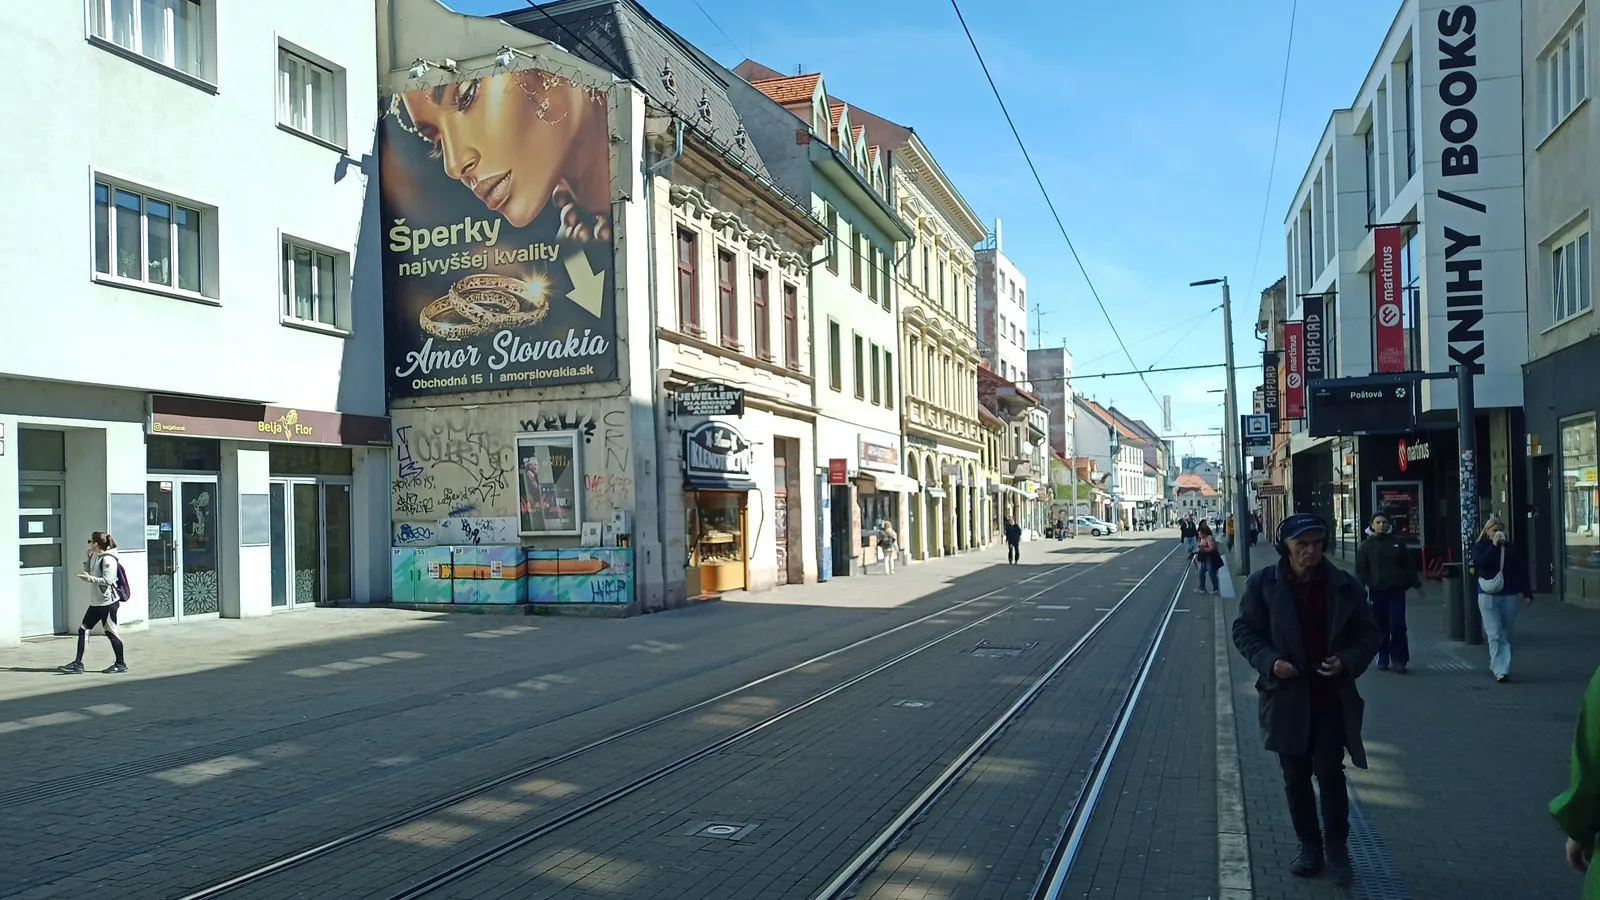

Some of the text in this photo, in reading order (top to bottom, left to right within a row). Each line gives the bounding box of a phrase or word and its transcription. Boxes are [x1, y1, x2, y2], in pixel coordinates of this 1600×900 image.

[1438, 4, 1479, 177] BOOKS
[389, 217, 501, 256] Šperky
[399, 242, 560, 277] najvyššej kvality
[1380, 245, 1393, 301] martinus
[1444, 225, 1485, 375] KNIHY
[395, 328, 609, 378] Amor Slovakia
[1288, 334, 1297, 372] martinus
[412, 374, 468, 390] Obchodná
[471, 375, 483, 384] 15
[499, 364, 594, 382] amorslovakia.sk
[1350, 389, 1383, 399] Poštová
[678, 391, 741, 401] JEWELLERY
[258, 421, 313, 436] Belja Flor
[1406, 438, 1430, 462] martinus
